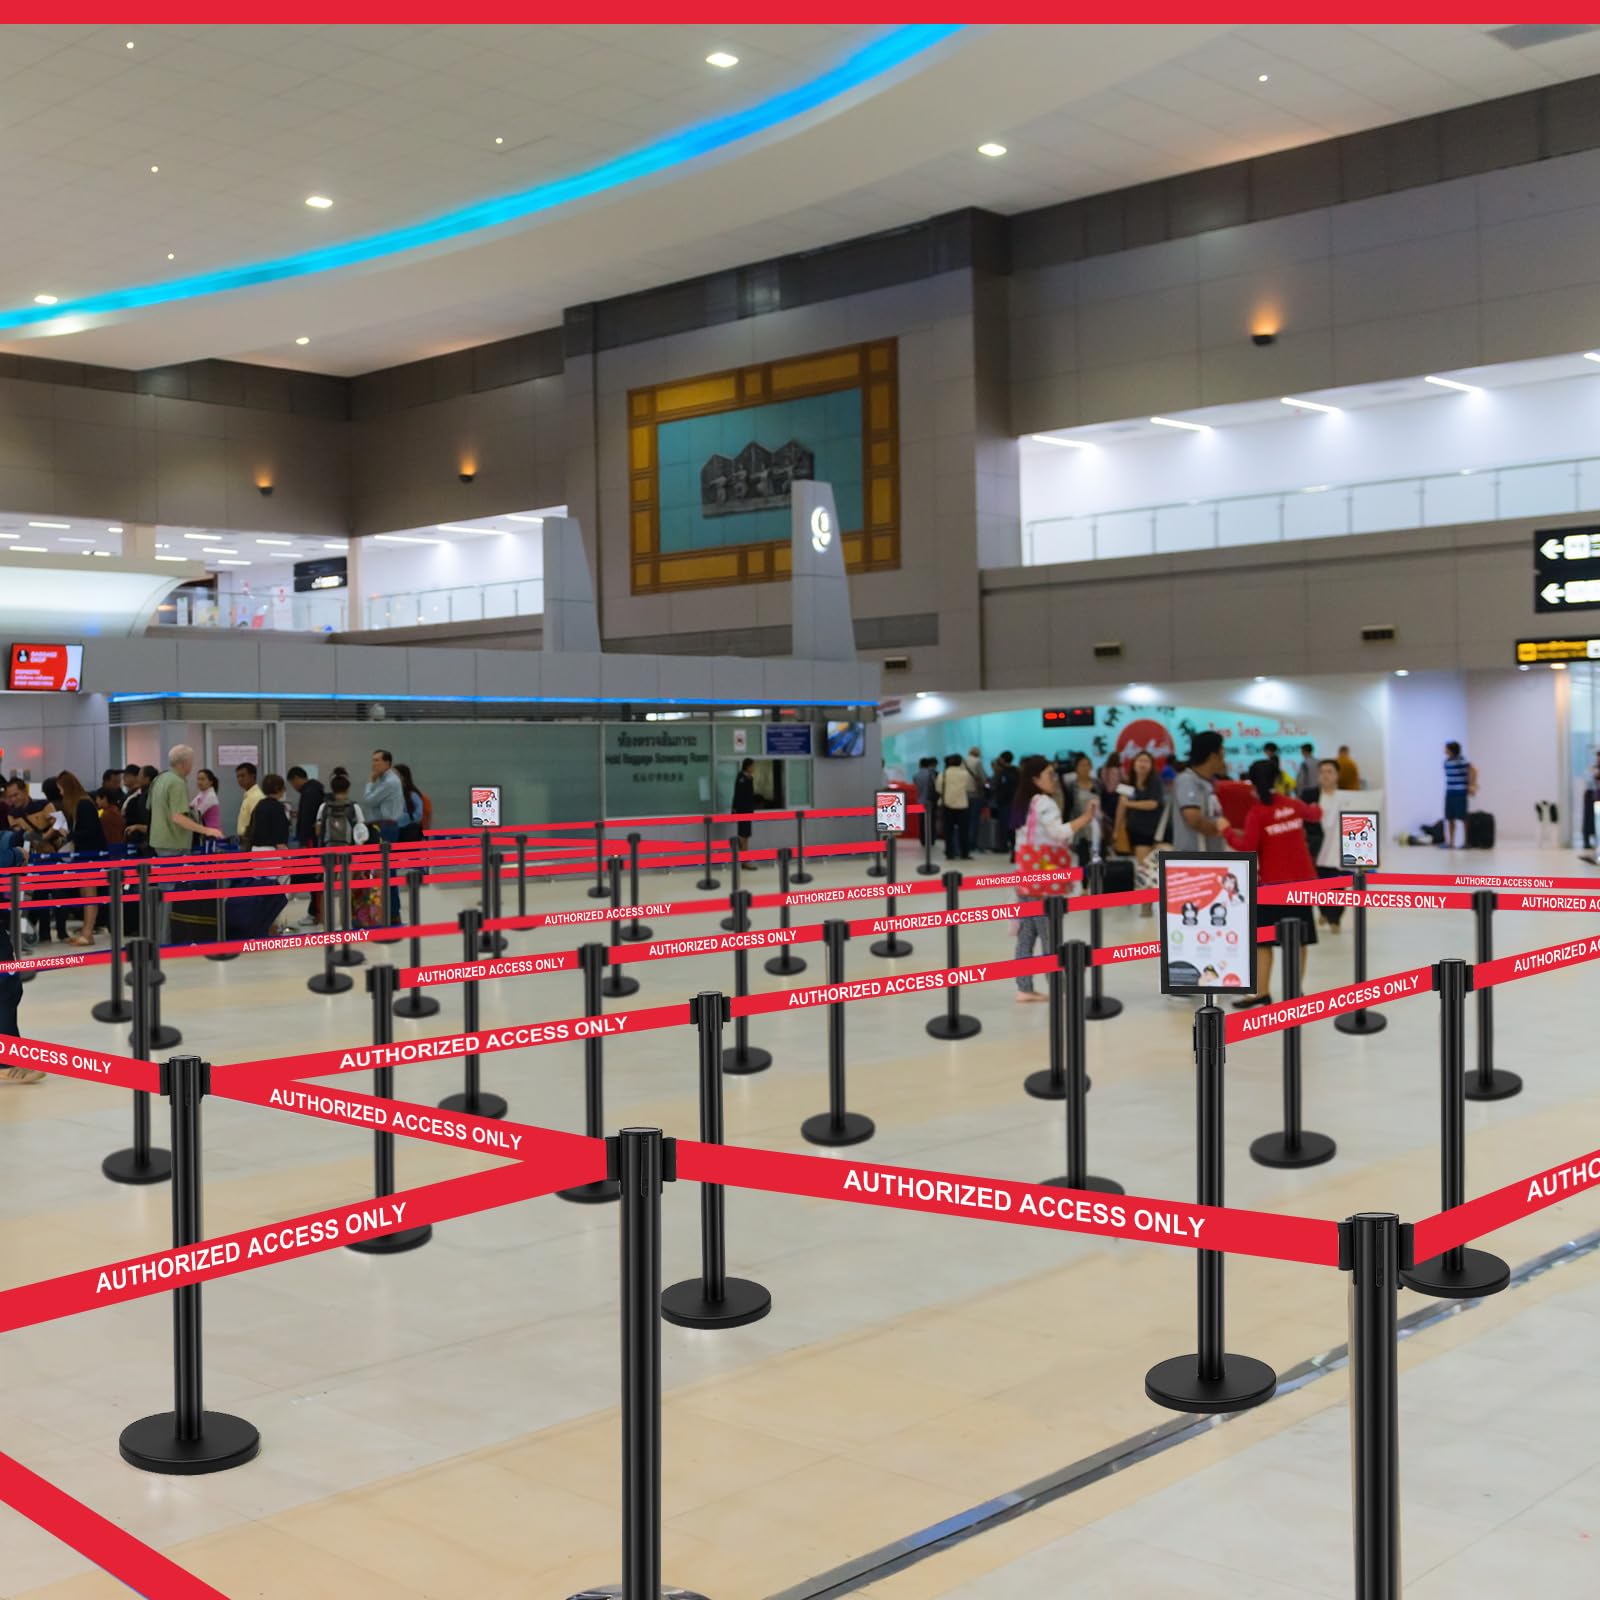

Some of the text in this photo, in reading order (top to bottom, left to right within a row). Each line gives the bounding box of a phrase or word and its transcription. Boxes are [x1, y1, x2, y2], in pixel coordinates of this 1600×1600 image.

[976, 872, 1071, 885] AUTHORIZED ACCESS ONLY
[1456, 877, 1553, 888] AUTHORIZED ACCESS ONLY
[786, 884, 913, 903] AUTHORIZED ACCESS ONLY
[1286, 891, 1447, 906] AUTHORIZED ACCESS ONLY
[1522, 897, 1586, 909] AUTHORIZED
[545, 906, 672, 924] AUTHORIZED ACCESS ONLY
[873, 906, 1020, 931] AUTHORIZED ACCESS ONLY
[243, 931, 369, 951] AUTHORIZED ACCESS ONLY
[650, 930, 796, 955] AUTHORIZED ACCESS ONLY
[1113, 944, 1160, 958] AUTHORI
[37, 959, 65, 967] ACCESS
[417, 957, 564, 982] AUTHORIZED ACCESS ONLY
[1514, 943, 1586, 972] AUTHORIZED
[788, 968, 986, 1005] AUTHORIZED ACCESS ONLY
[1242, 975, 1419, 1031] AUTHORIZED ACCESS ONLY
[340, 1016, 628, 1068] AUTHORIZED ACCESS ONLY
[9, 1044, 68, 1065] ACCESS
[72, 1056, 111, 1074] ONLY
[270, 1089, 523, 1150] AUTHORIZED ACCESS ONLY
[844, 1170, 1206, 1238] AUTHORIZED ACCESS ONLY
[96, 1202, 407, 1293] AUTHORIZED ACCESS ONLY
